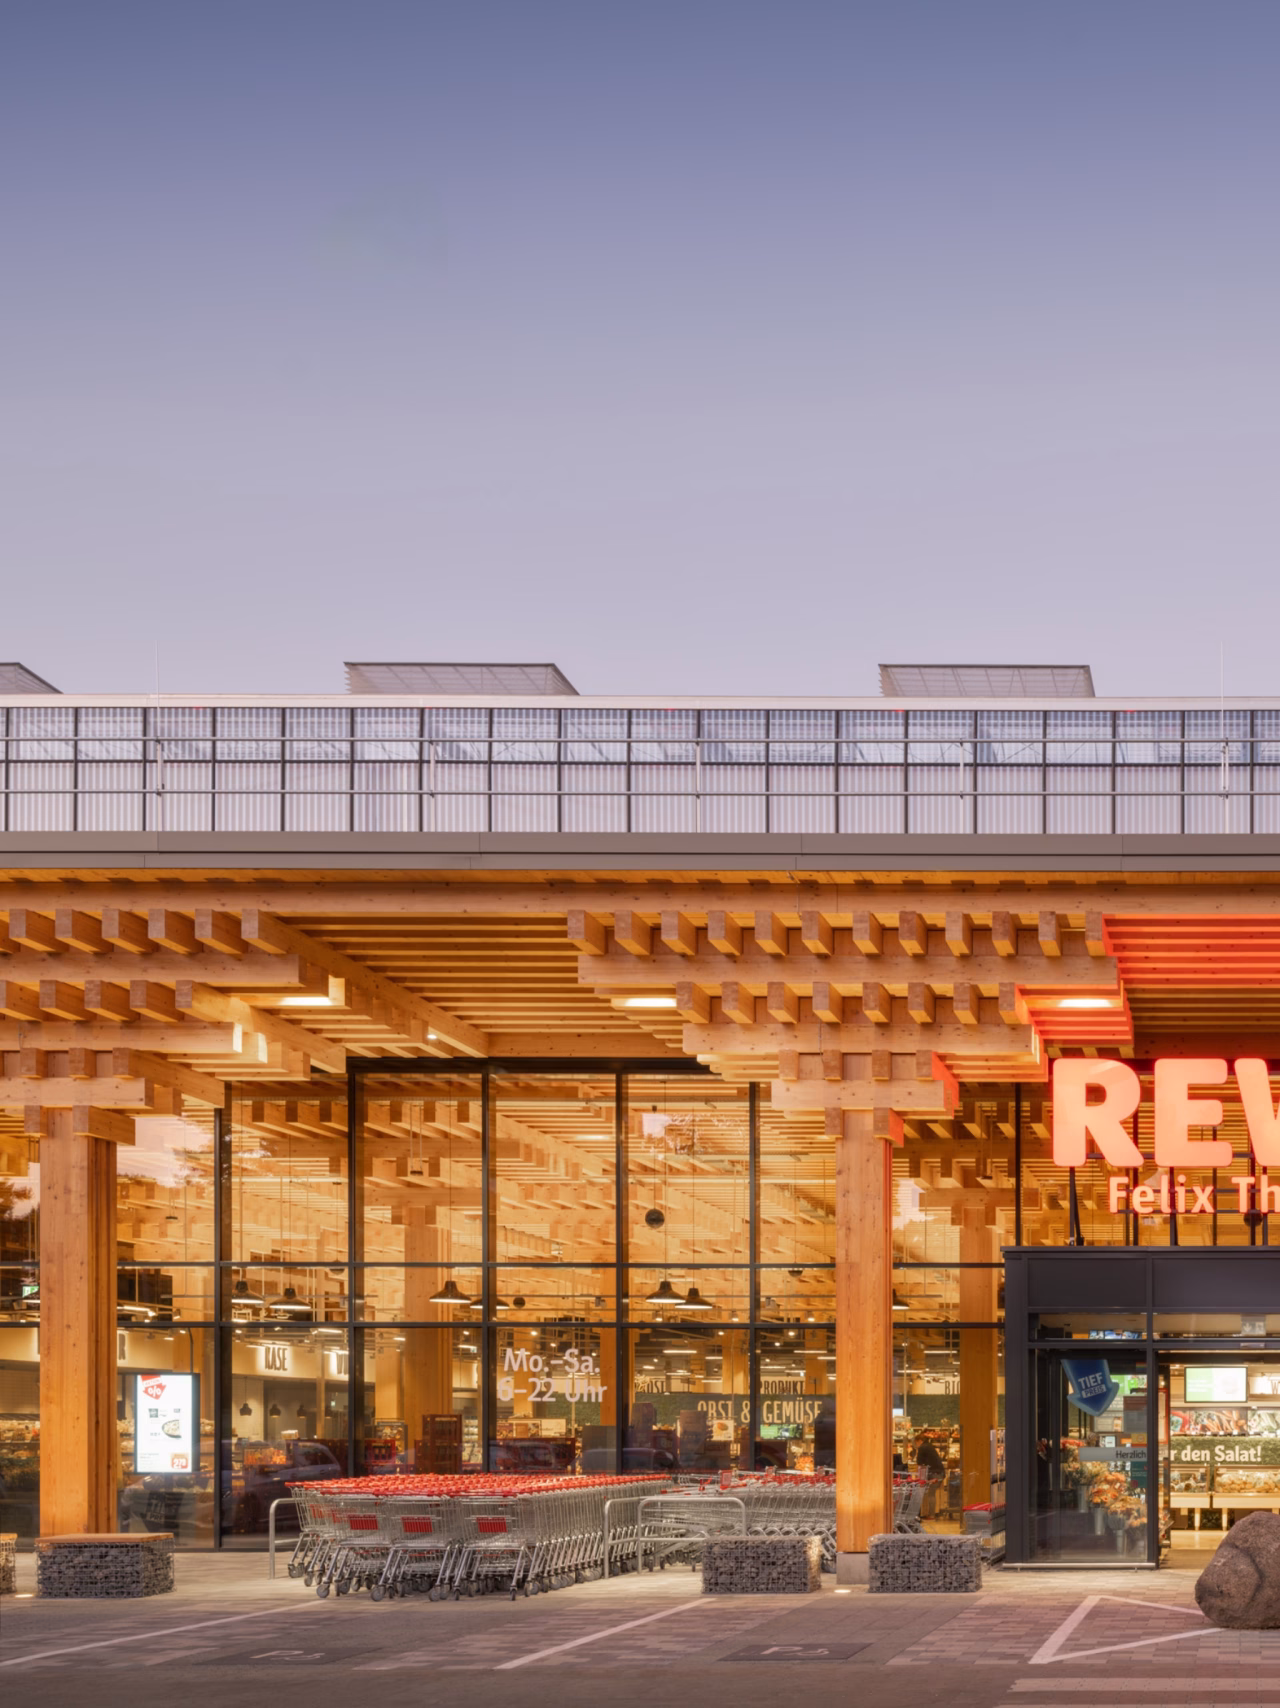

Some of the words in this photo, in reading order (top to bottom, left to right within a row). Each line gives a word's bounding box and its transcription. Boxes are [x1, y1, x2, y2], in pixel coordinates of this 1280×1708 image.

[1109, 1174, 1215, 1214] Felix
[564, 1377, 608, 1403] Uhr
[1078, 1372, 1103, 1390] TIEF
[1115, 1450, 1147, 1459] Herzlich
[1181, 1446, 1210, 1462] den
[1214, 1445, 1262, 1462] Salat!
